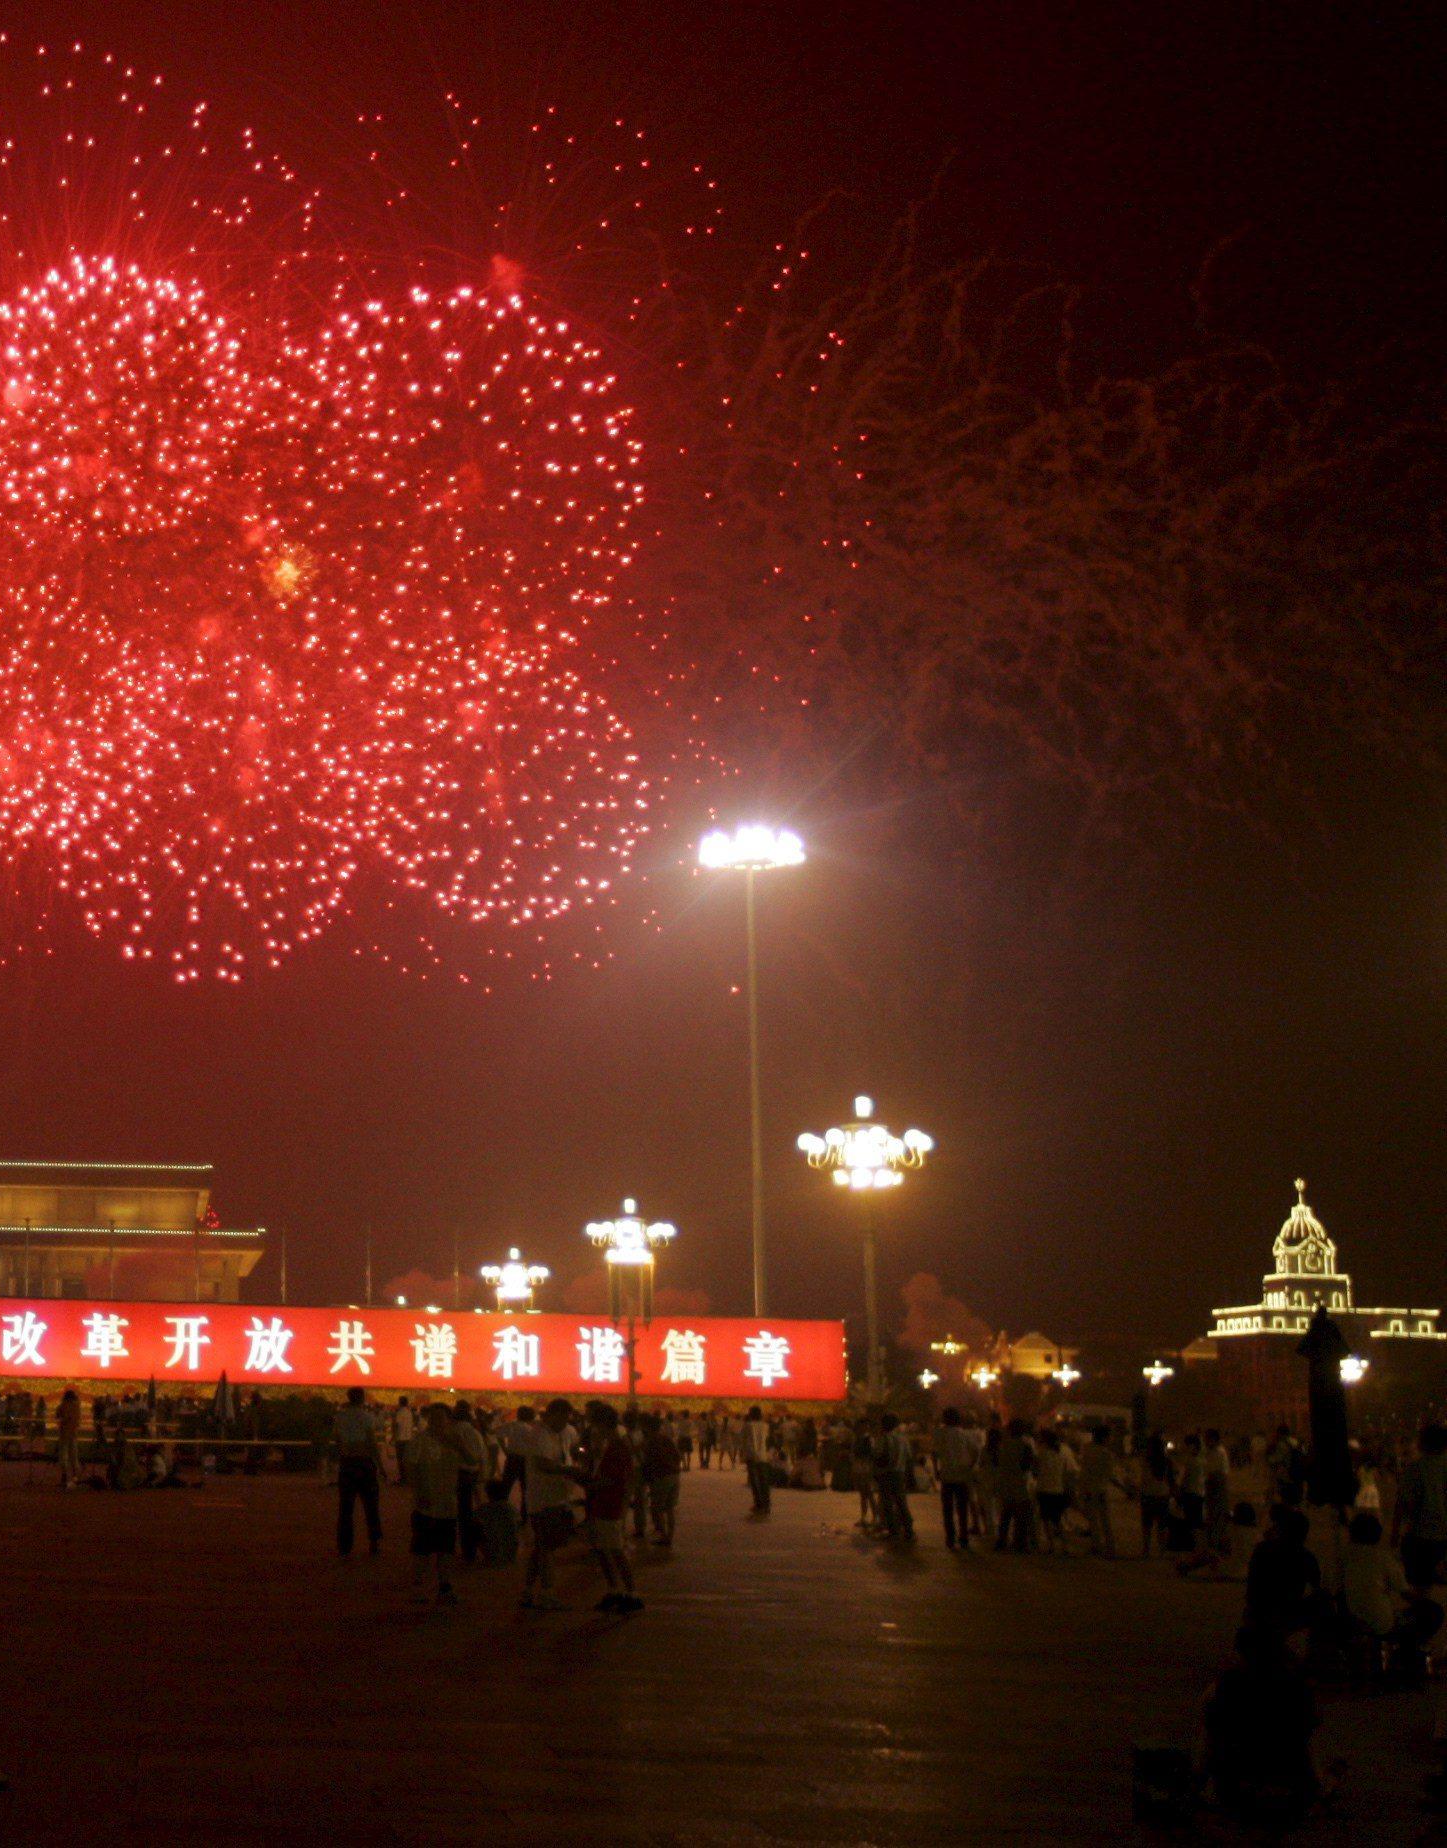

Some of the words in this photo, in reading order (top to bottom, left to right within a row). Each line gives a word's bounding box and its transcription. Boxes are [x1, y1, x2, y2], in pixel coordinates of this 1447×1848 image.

[0, 1310, 792, 1388] 改革开放共谱和谐篇章
